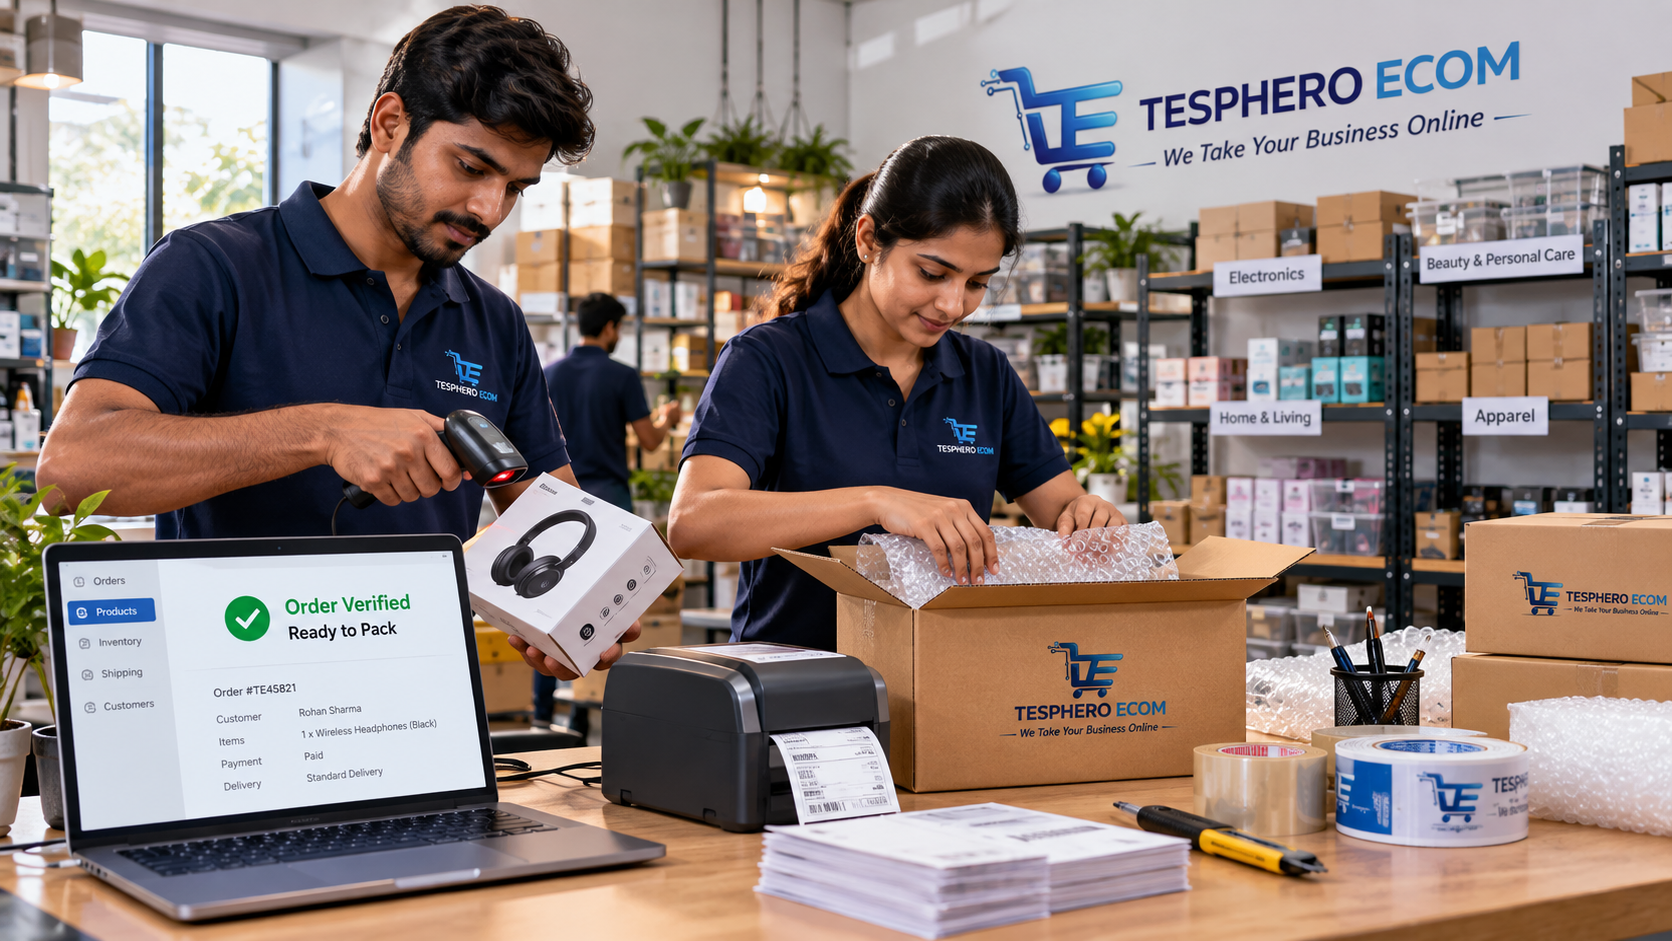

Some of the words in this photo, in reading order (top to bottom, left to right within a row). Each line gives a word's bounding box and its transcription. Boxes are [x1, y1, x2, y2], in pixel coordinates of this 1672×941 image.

[1140, 66, 1362, 132] TESPHERO
[1376, 40, 1520, 99] ECOM
[1163, 146, 1193, 167] We
[1200, 139, 1246, 163] Take
[1252, 135, 1299, 156] Your
[1305, 122, 1399, 149] Business
[1407, 109, 1484, 136] Online
[1427, 256, 1470, 271] Beauty
[1473, 253, 1483, 267] &
[1485, 250, 1541, 266] Personal
[1544, 248, 1576, 262] Care
[1229, 267, 1305, 285] Electronics
[435, 380, 478, 396] TESPHERO
[1219, 411, 1257, 425] Home
[1260, 410, 1270, 424] &
[1272, 410, 1312, 427] Living
[1474, 409, 1535, 427] Apparel
[93, 576, 126, 586] Orders
[284, 597, 338, 616] Order
[342, 593, 411, 613] Verified
[1566, 590, 1629, 605] TESPHERO
[1631, 593, 1667, 606] ECOM
[96, 606, 138, 617] Products
[288, 624, 337, 642] Ready
[341, 624, 357, 637] to
[361, 621, 397, 637] Pack
[98, 637, 142, 648] Inventory
[101, 668, 143, 679] Shipping
[213, 687, 244, 698] Order
[246, 683, 297, 695] #TE45821
[103, 700, 155, 712] Customers
[299, 707, 327, 718] Rohan
[329, 704, 362, 715] Sharma
[1014, 702, 1112, 721] TESPHERO
[1116, 700, 1166, 717] ECOM
[216, 713, 262, 724] Customer
[301, 730, 306, 739] 1
[315, 727, 353, 738] Wireless
[354, 722, 408, 735] Headphones
[409, 719, 437, 731] (Black)
[1020, 728, 1035, 738] We
[1038, 726, 1060, 737] Take
[1063, 725, 1083, 736] Your
[1086, 724, 1126, 735] Business
[1128, 722, 1159, 733] Online
[219, 737, 245, 747] Items
[221, 757, 263, 770] Payment
[304, 751, 324, 761] Paid
[306, 770, 347, 783] Standard
[349, 768, 384, 779] Delivery
[223, 780, 262, 792] Delivery
